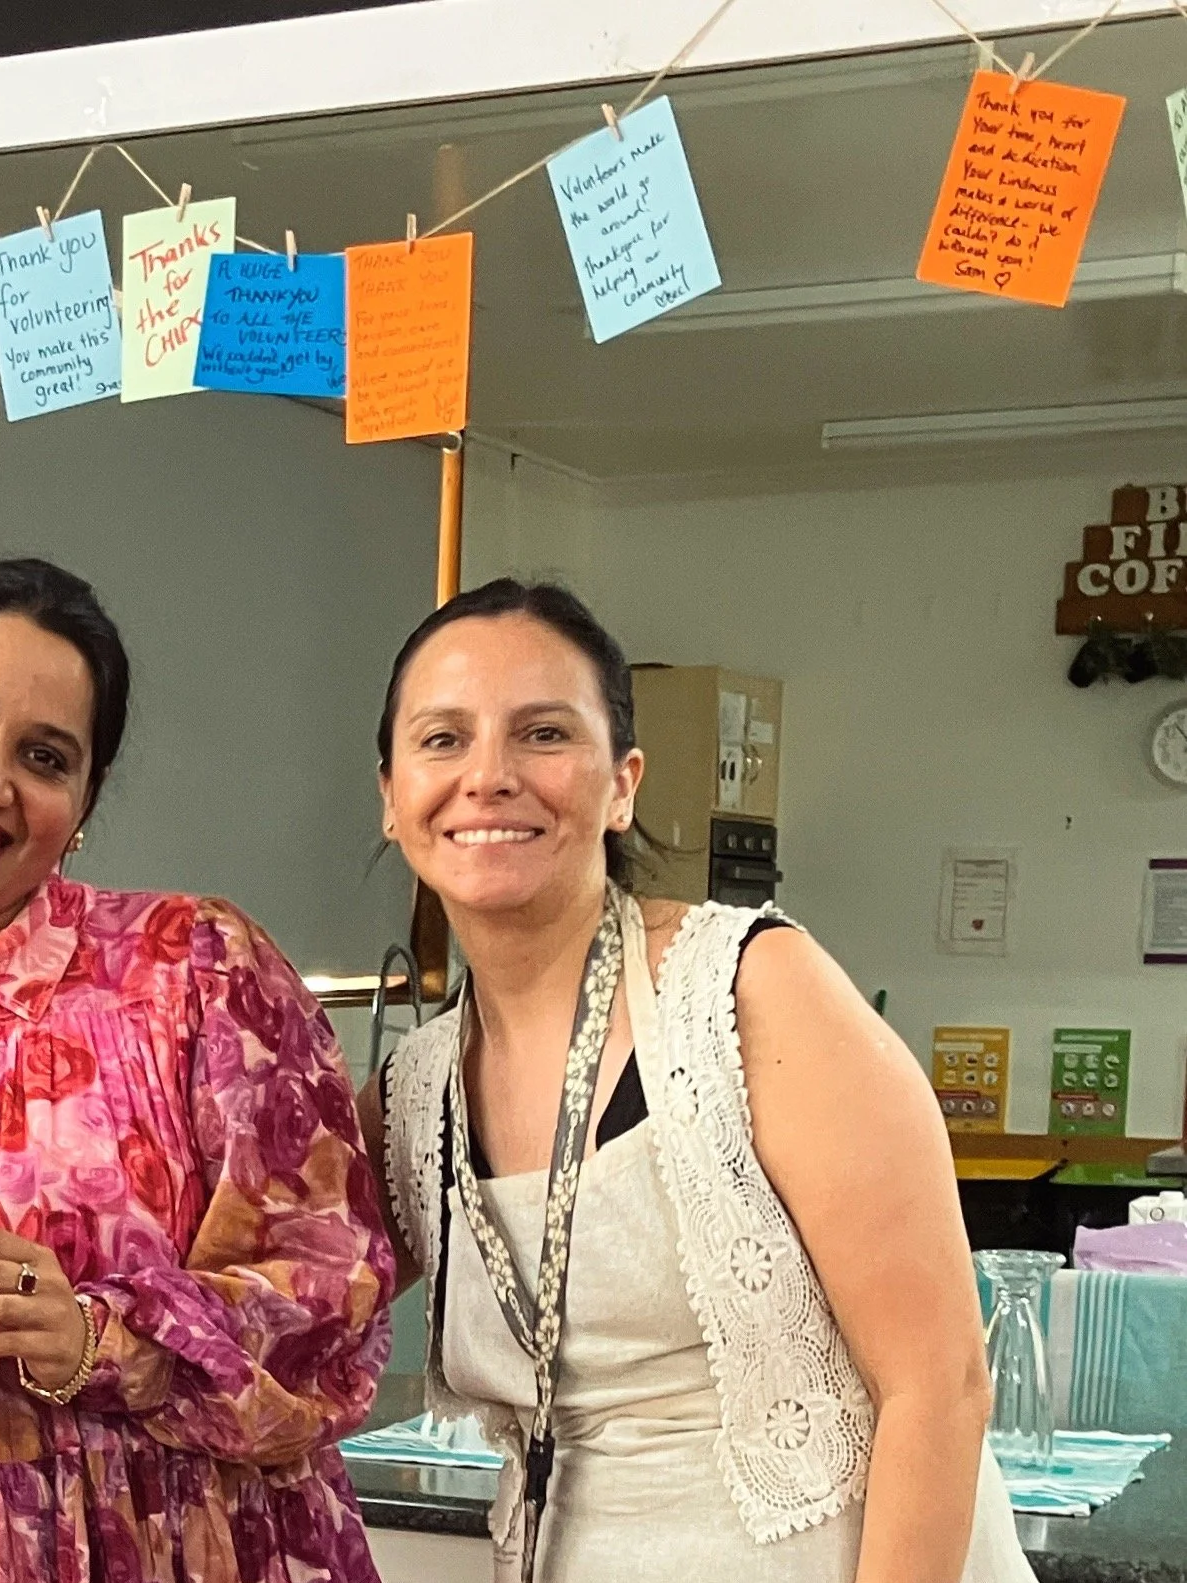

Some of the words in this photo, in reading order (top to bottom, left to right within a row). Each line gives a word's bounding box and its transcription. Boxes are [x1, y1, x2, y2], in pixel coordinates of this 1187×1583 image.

[60, 232, 96, 273] you
[128, 220, 221, 283] Thanks
[136, 298, 180, 334] the
[38, 341, 74, 360] make
[80, 328, 109, 346] this
[21, 354, 93, 384] community
[1146, 486, 1187, 522] B
